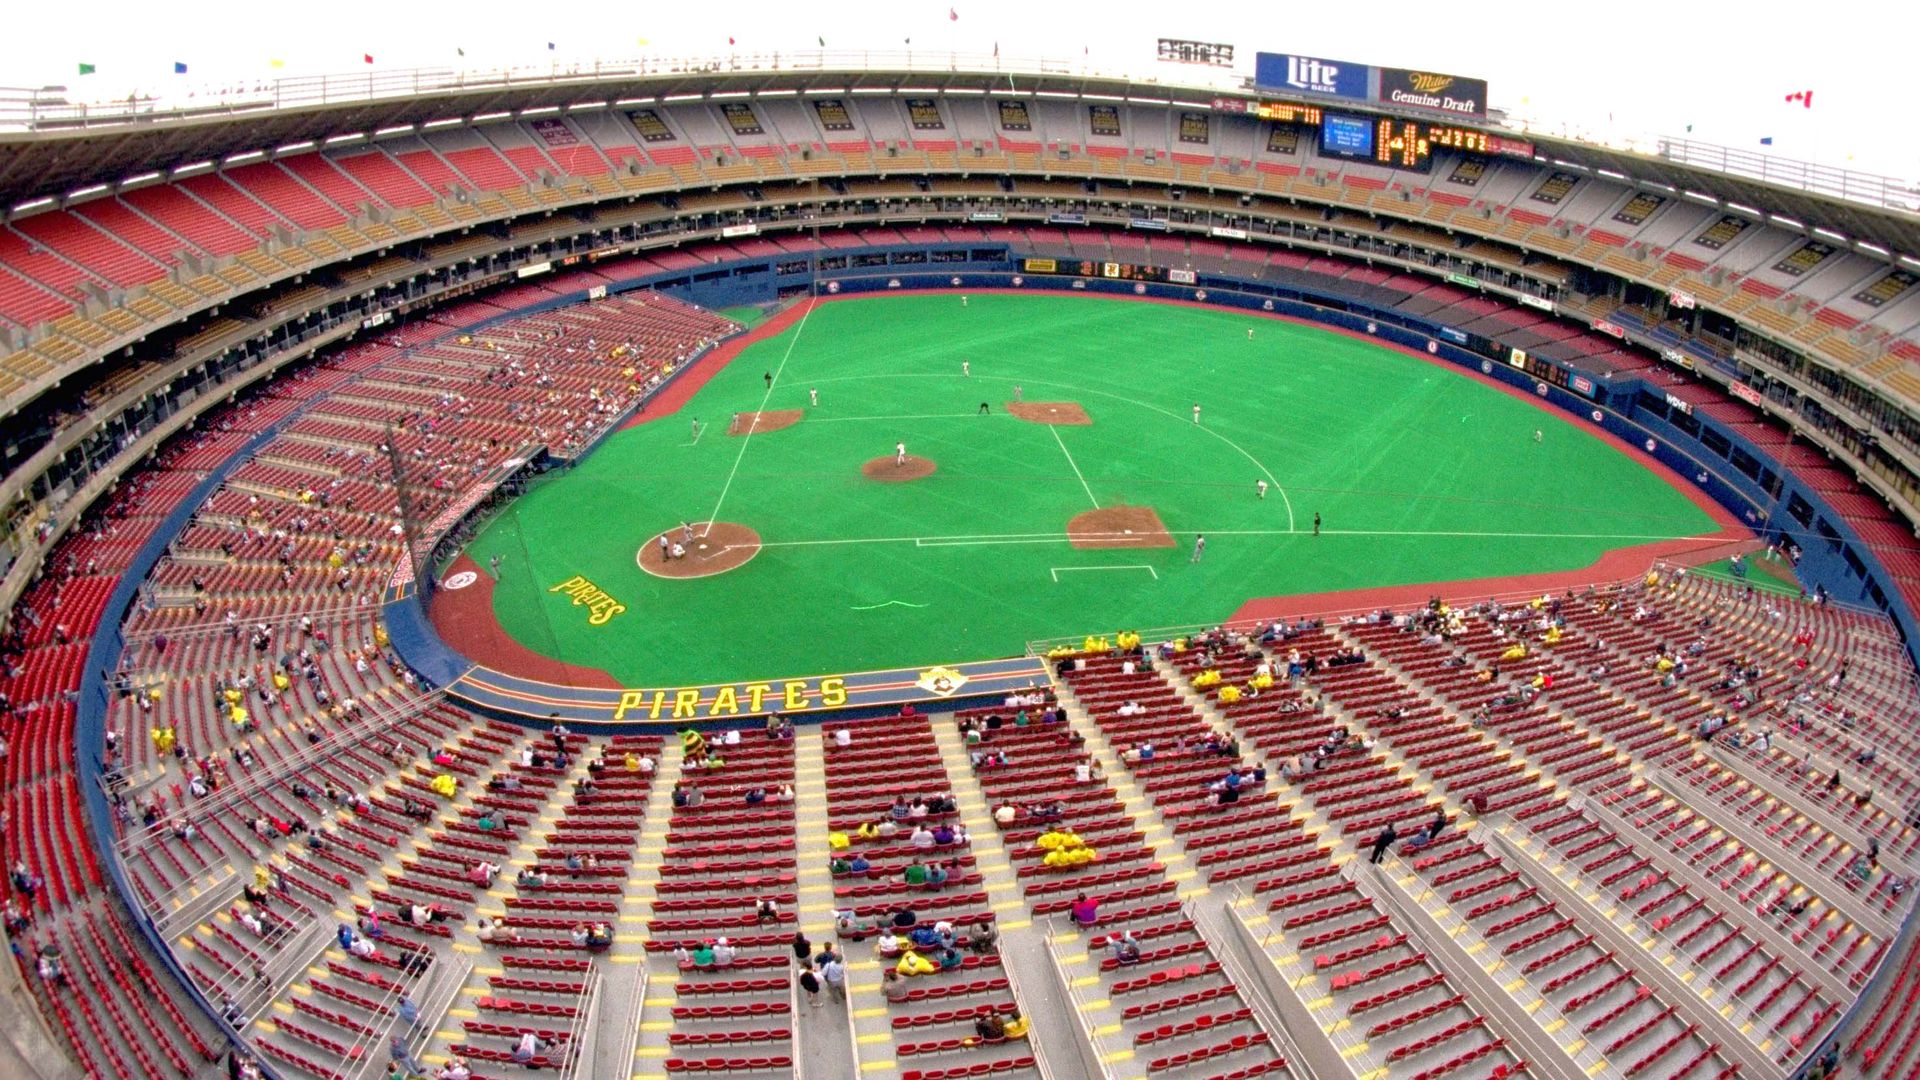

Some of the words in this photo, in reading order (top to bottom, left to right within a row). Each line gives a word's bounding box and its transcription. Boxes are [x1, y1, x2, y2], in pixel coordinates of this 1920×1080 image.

[1287, 57, 1338, 89] Lite
[1409, 73, 1454, 93] Miller
[1311, 85, 1336, 93] BEER
[1392, 89, 1440, 107] Genuine
[1443, 97, 1475, 112] Draft
[549, 575, 626, 625] PIRATES
[614, 677, 847, 720] PIRATES
